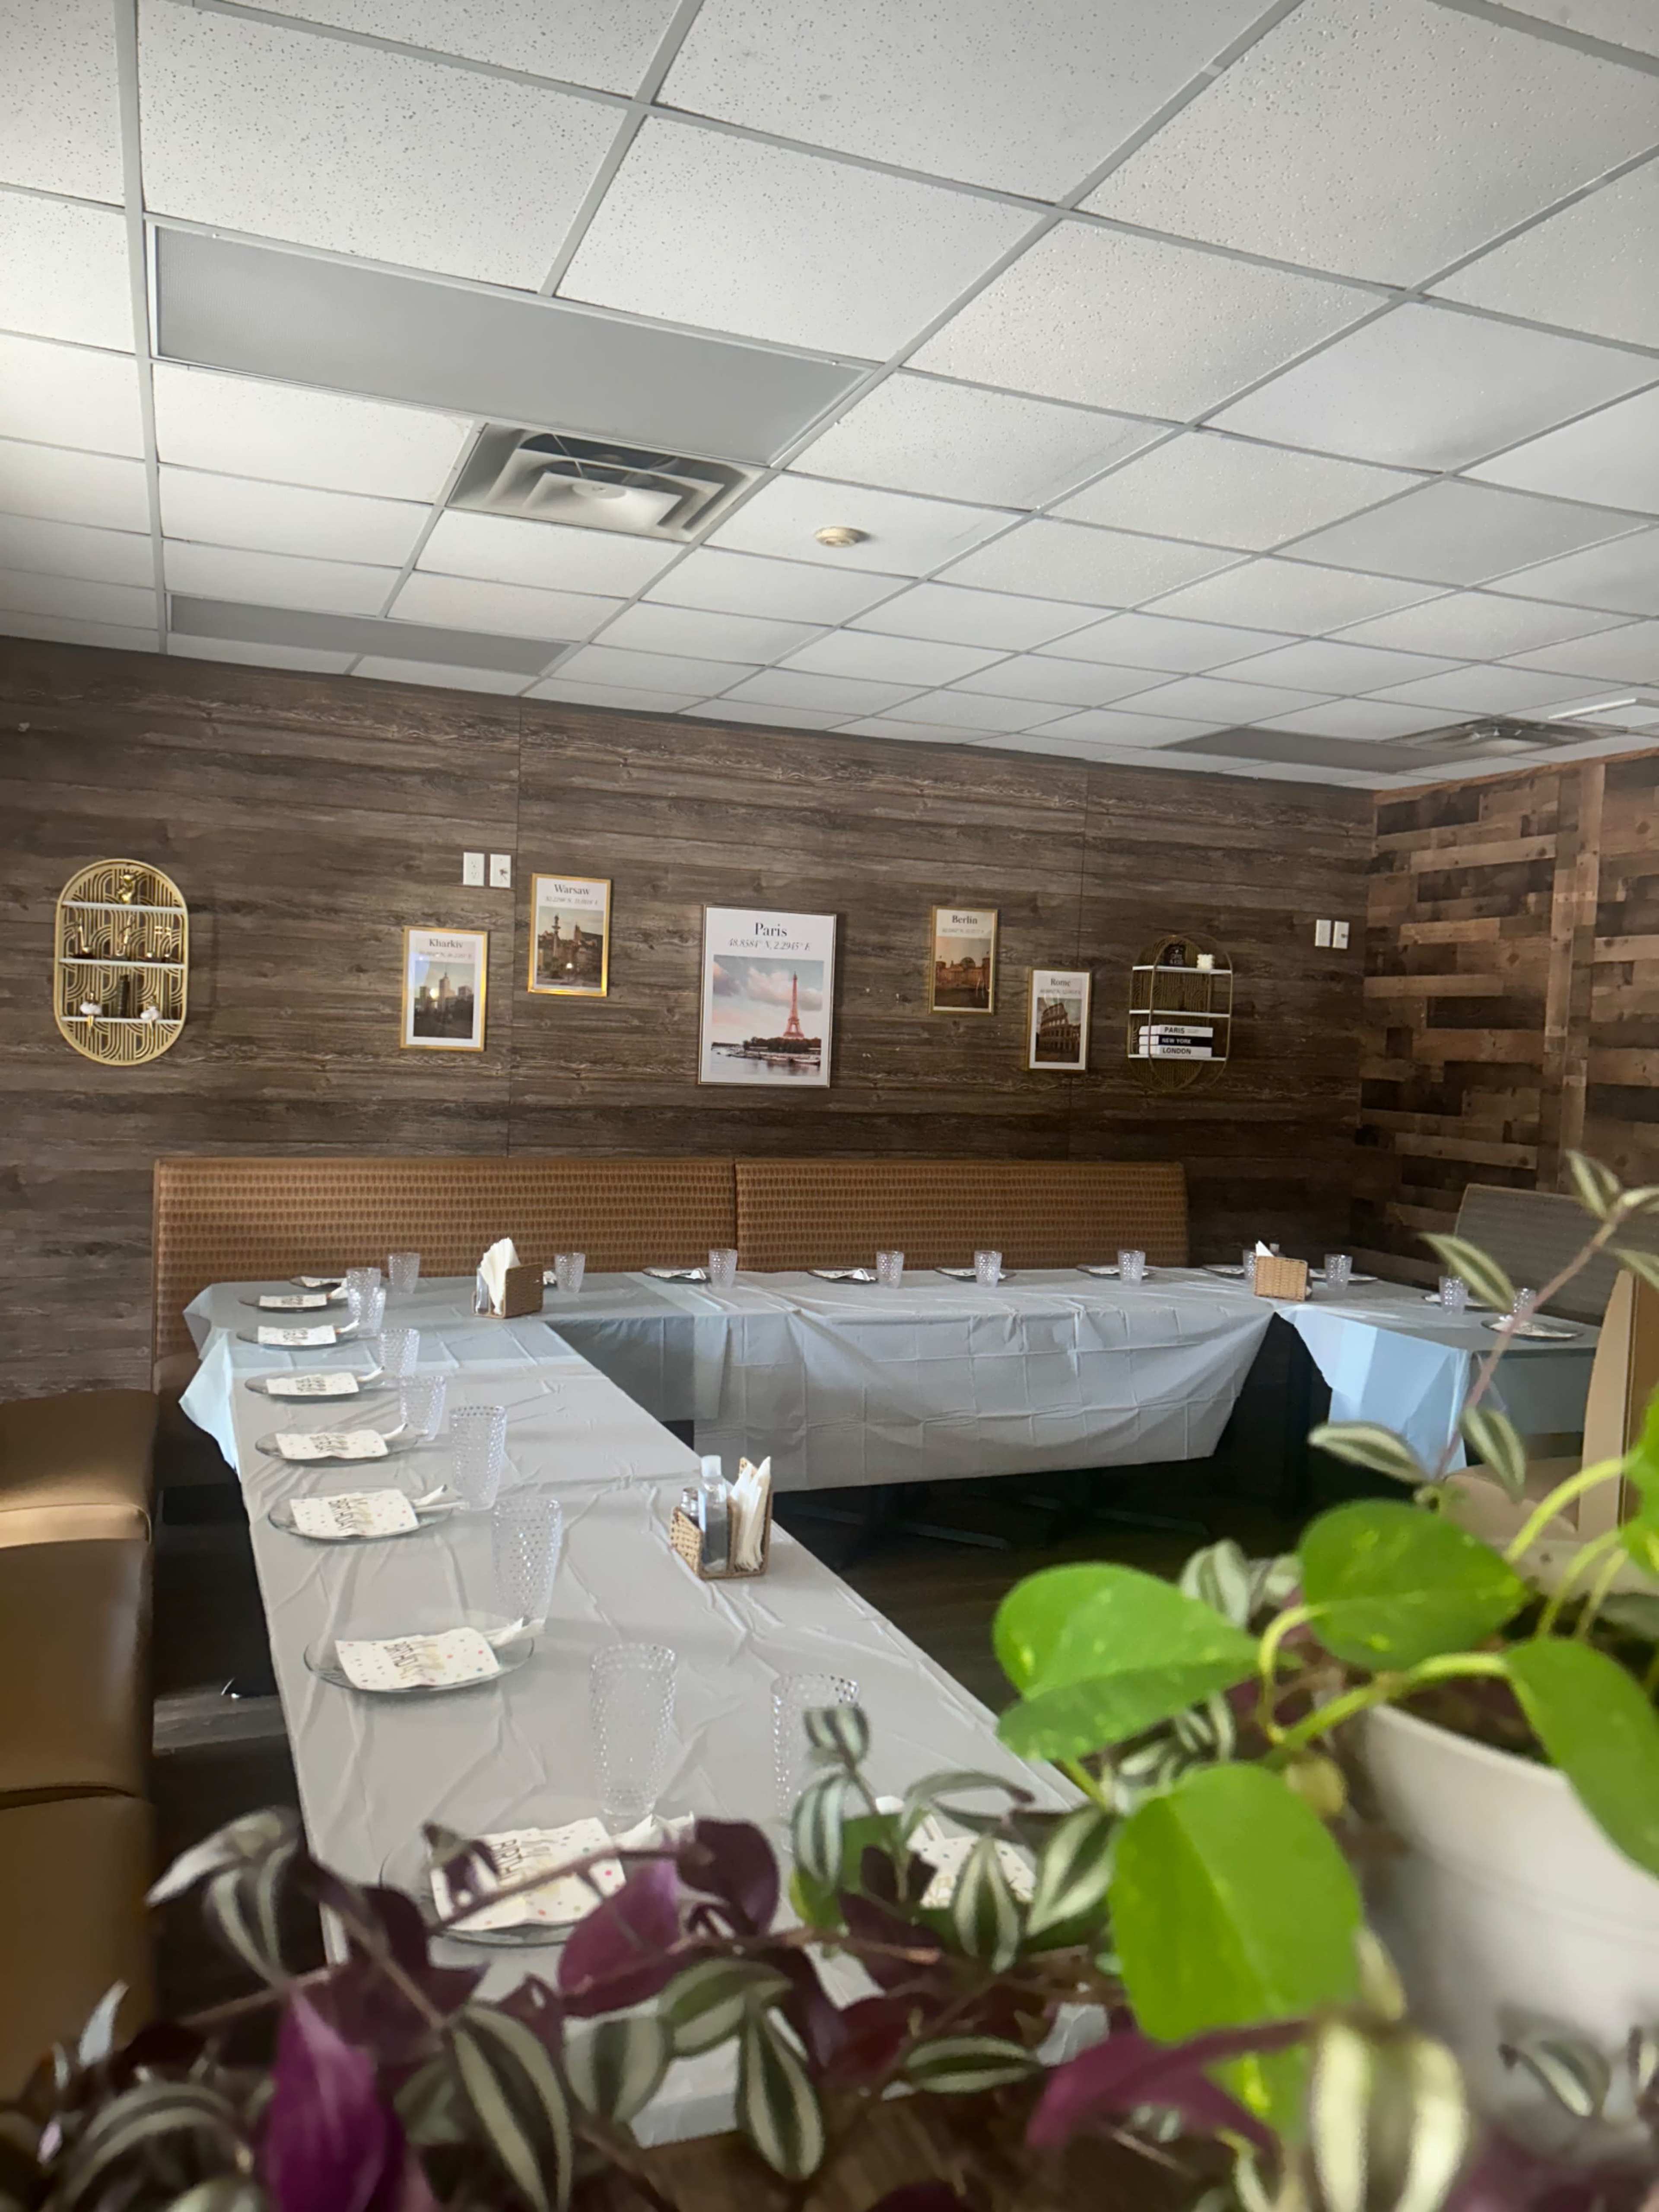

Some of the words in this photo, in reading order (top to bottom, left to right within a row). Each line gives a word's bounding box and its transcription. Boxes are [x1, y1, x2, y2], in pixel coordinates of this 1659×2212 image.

[554, 884, 590, 895] Warsaw
[952, 914, 978, 925] Berlin
[755, 922, 788, 937] Paris
[429, 938, 464, 948] Kharkiv
[1050, 978, 1071, 987] Rome
